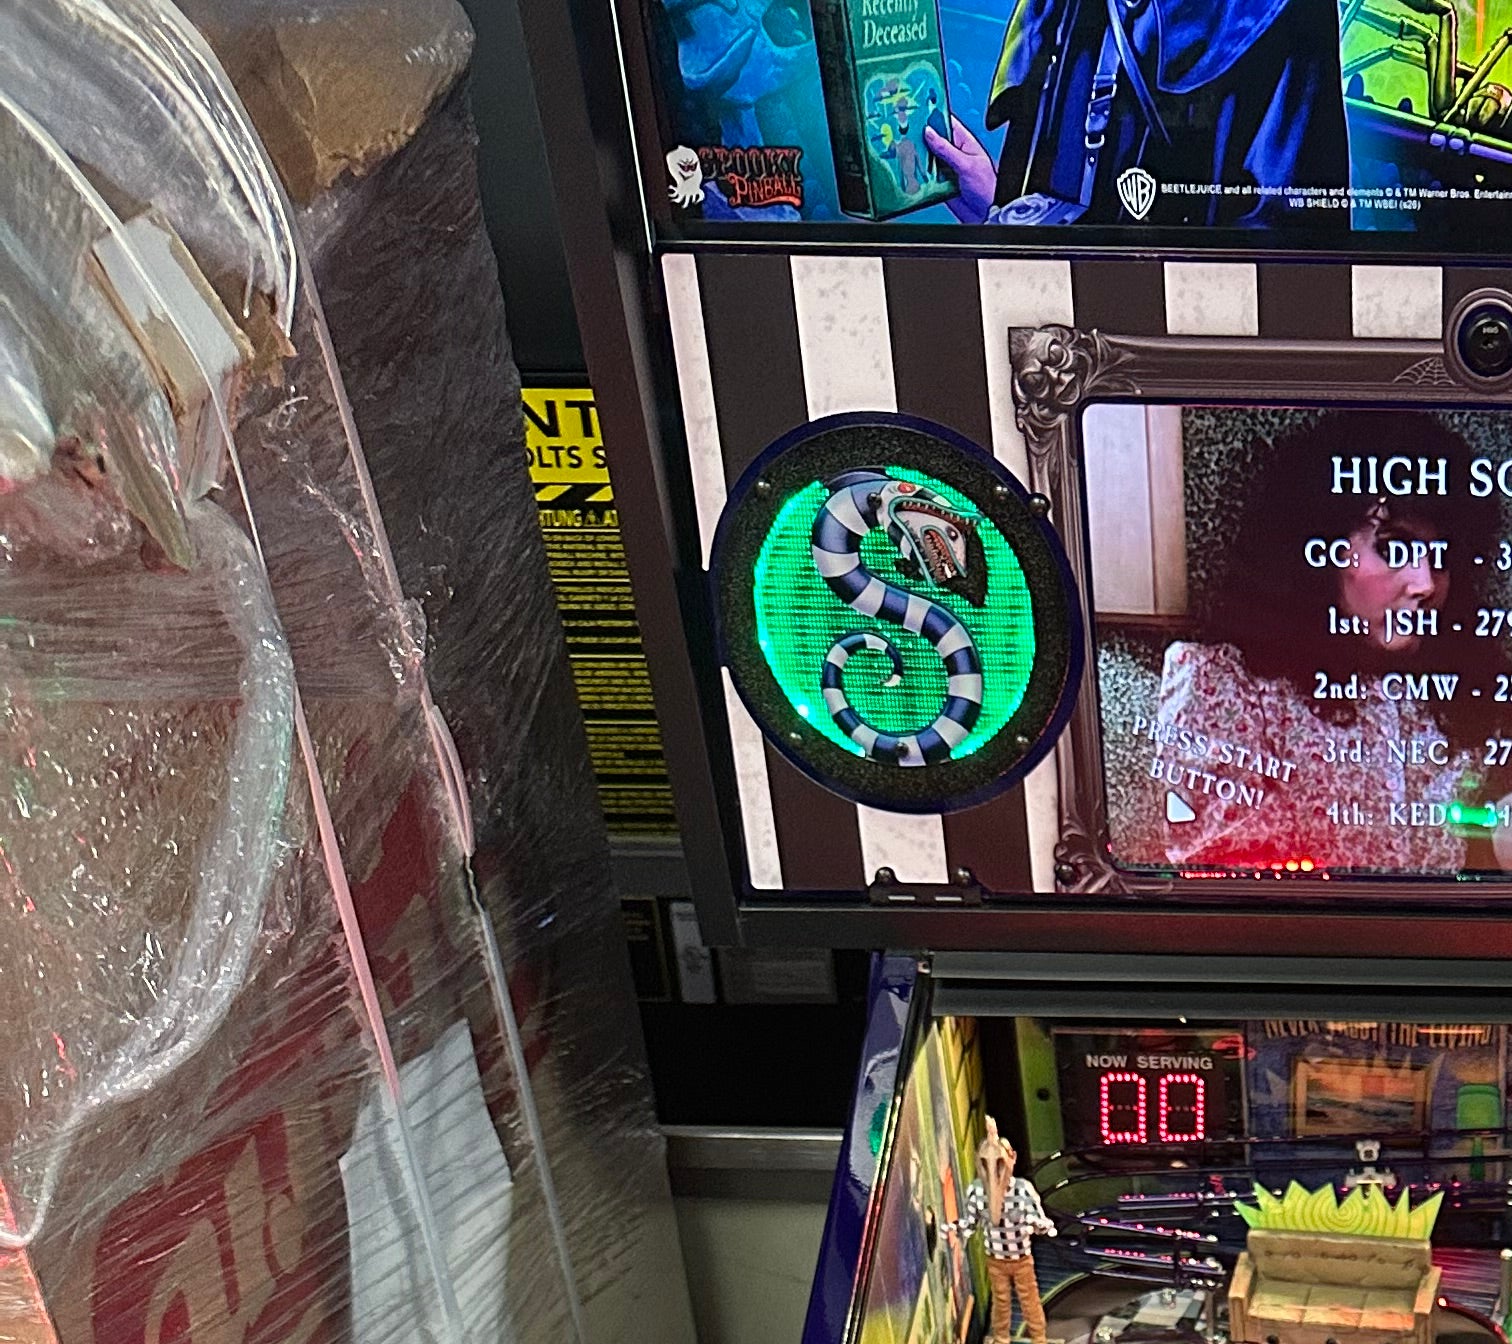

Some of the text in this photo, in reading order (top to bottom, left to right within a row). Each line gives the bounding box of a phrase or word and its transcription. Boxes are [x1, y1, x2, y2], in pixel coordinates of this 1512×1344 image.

[863, 18, 928, 48] Deceased
[728, 173, 801, 205] PINBALL
[1161, 183, 1327, 197] BEETLEJUICE characters
[1307, 198, 1339, 208] SHIELD
[1332, 457, 1448, 497] HIGH
[1304, 540, 1361, 569] GC:
[1388, 541, 1449, 571] DPT
[1329, 607, 1370, 636] 1st:
[1384, 608, 1440, 644] JSH
[1313, 673, 1367, 701] 2nd:
[1382, 675, 1460, 702] CMW
[1131, 714, 1297, 784] PRESS START
[1322, 738, 1372, 765] 3rd:
[1386, 739, 1449, 767] NEC
[1148, 758, 1265, 811] BUTTON!
[1326, 803, 1373, 830] 4th:
[1388, 802, 1447, 827] KED
[1086, 1053, 1214, 1071] NOW SERVING
[1100, 1071, 1205, 1145] 00
